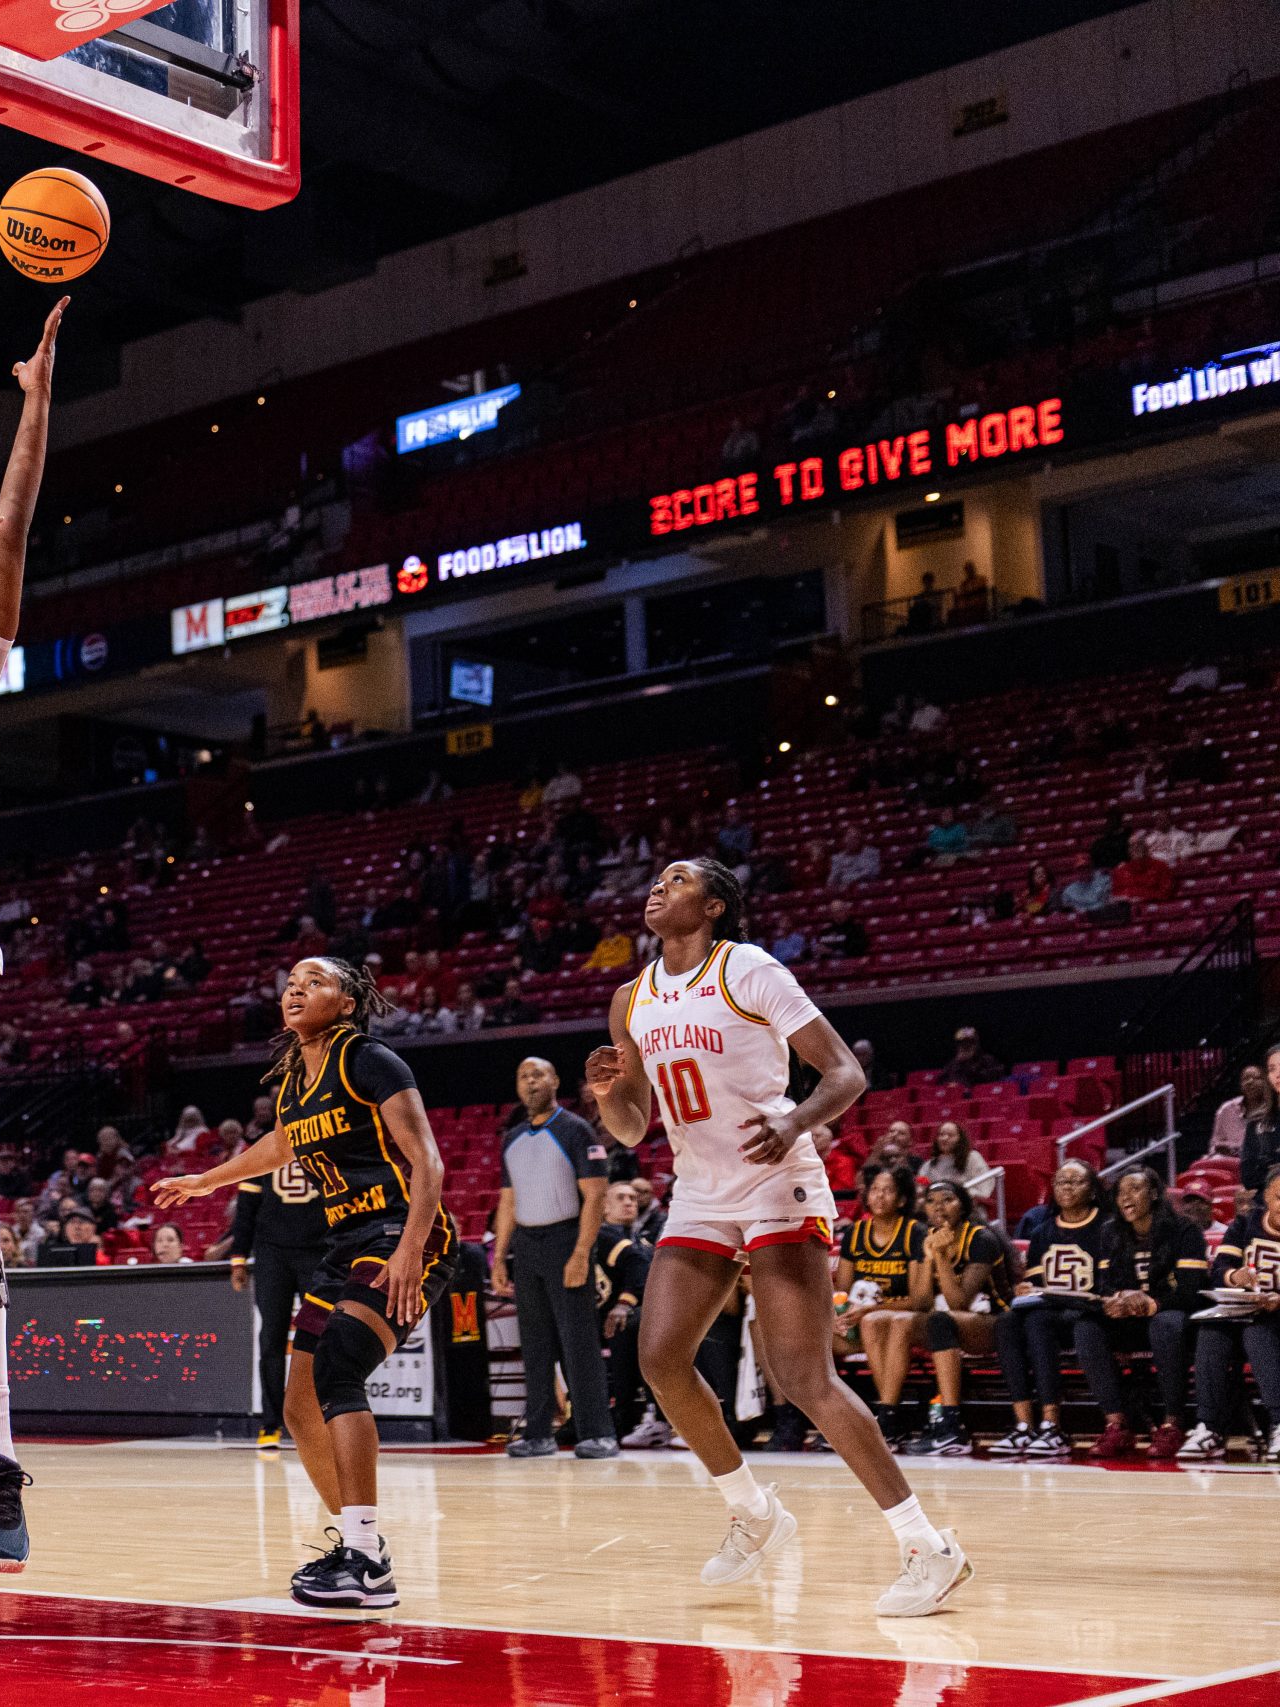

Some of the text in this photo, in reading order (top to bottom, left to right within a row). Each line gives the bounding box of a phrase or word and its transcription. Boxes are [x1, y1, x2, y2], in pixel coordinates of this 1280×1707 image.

[7, 217, 76, 252] Wilson
[11, 255, 64, 276] NCAA
[1132, 350, 1280, 416] Food Lion wi
[773, 457, 824, 506] TO
[838, 430, 932, 491] GIVE
[945, 398, 1064, 467] MORE
[438, 522, 582, 582] FOOD LION
[1234, 580, 1272, 607] 101
[184, 603, 209, 642] M
[656, 1057, 713, 1127] 10
[300, 1151, 350, 1199] 11
[450, 1291, 480, 1337] M
